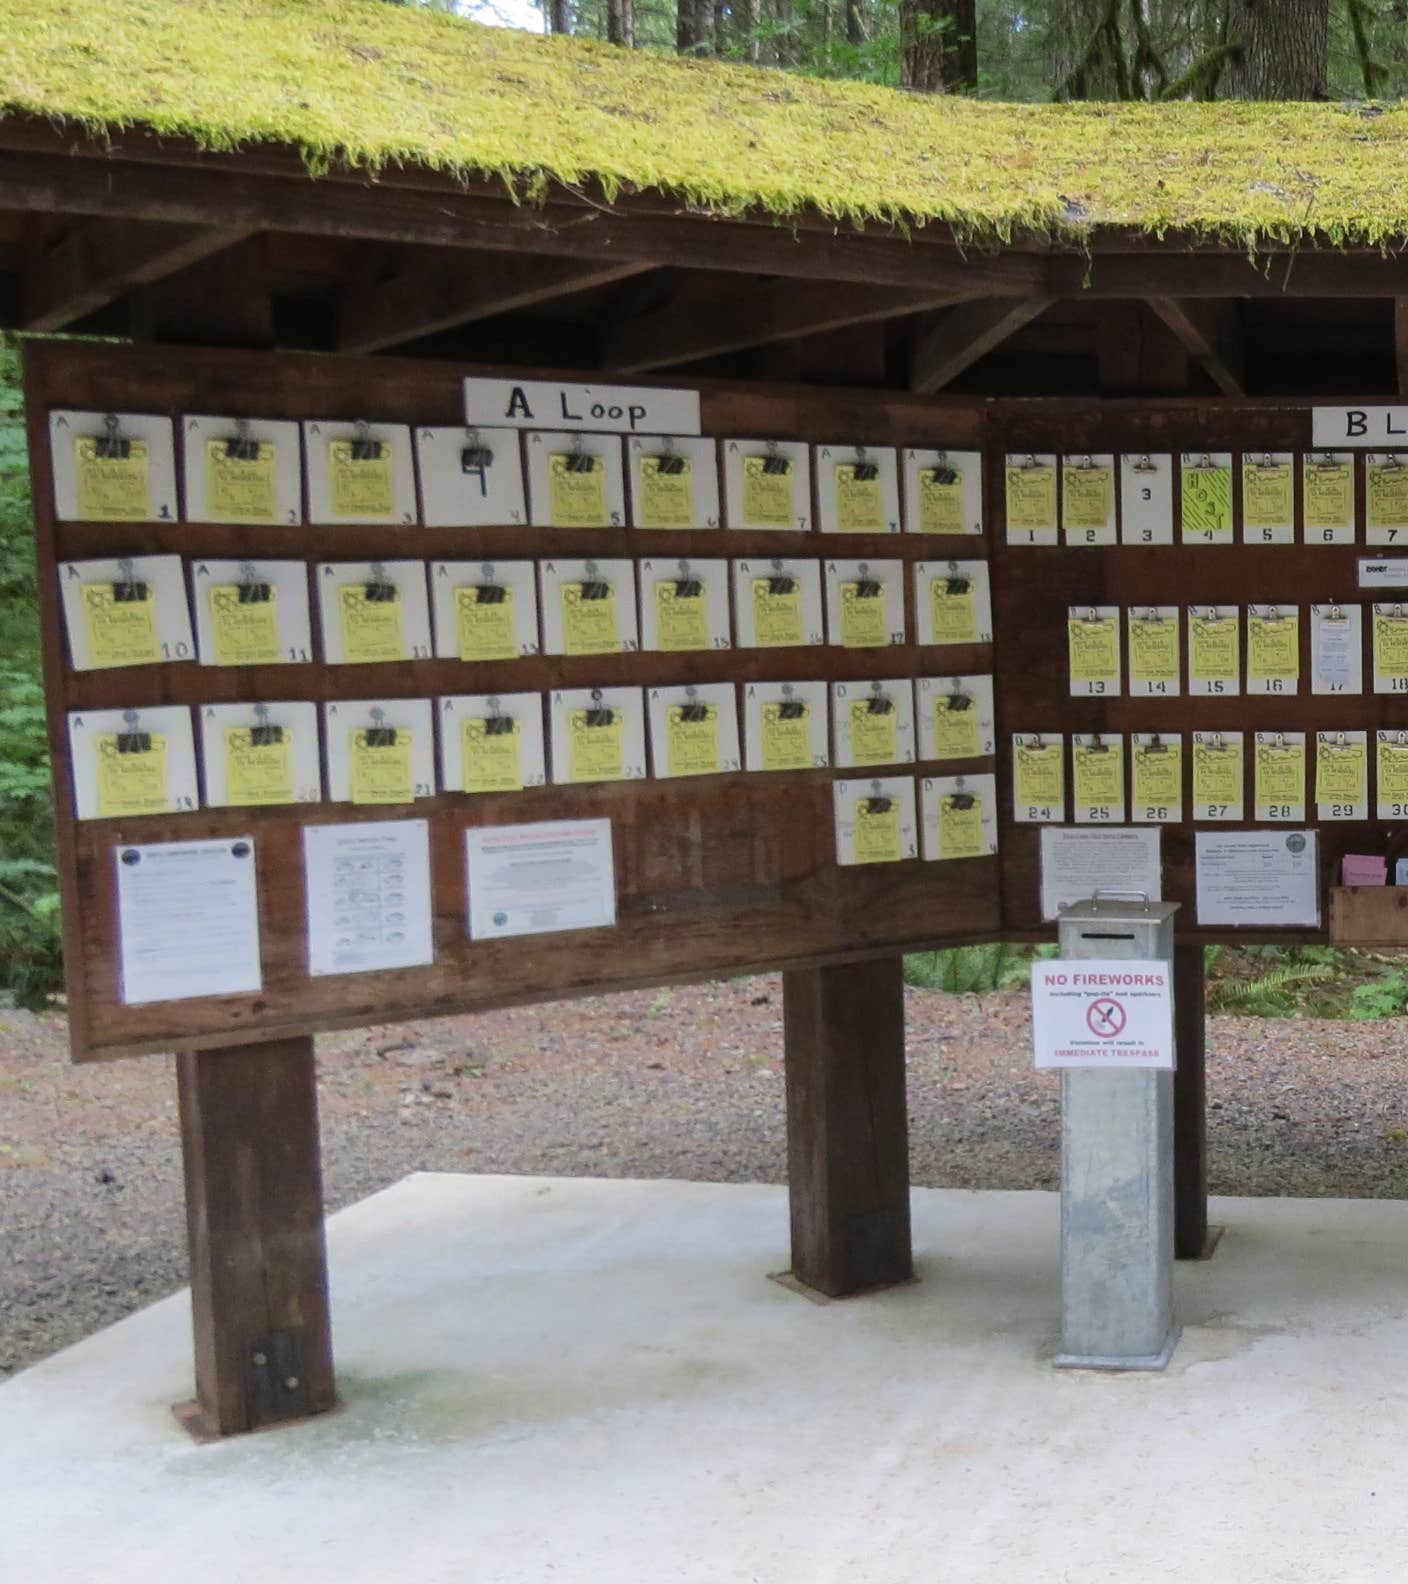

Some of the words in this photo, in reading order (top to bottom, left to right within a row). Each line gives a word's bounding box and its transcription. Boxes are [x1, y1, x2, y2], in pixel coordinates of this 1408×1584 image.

[505, 387, 535, 419] A
[560, 391, 647, 430] Loop
[1346, 411, 1368, 437] B
[1142, 488, 1151, 500] 3
[159, 504, 172, 519] 1
[1028, 530, 1035, 542] 1
[1086, 530, 1095, 541] 2
[1143, 530, 1152, 541] 3
[1204, 530, 1213, 540] 4
[1263, 528, 1272, 541] 5
[1324, 529, 1333, 541] 6
[1388, 529, 1397, 542] 7
[162, 642, 189, 659] 10
[1088, 681, 1105, 693] 13
[1148, 681, 1166, 693] 14
[1207, 680, 1224, 692] 15
[1266, 679, 1282, 691] 16
[1392, 678, 1408, 690] 18
[1029, 807, 1050, 819] 24
[1090, 808, 1109, 819] 25
[1146, 808, 1167, 819] 26
[1208, 805, 1228, 817] 27
[1269, 805, 1290, 817] 28
[1332, 804, 1353, 816] 29
[1044, 974, 1068, 986] NO
[1073, 974, 1164, 986] FIREWORKS
[1055, 1049, 1108, 1057] IMMEDIATE
[1111, 1048, 1160, 1057] TRESPASS
